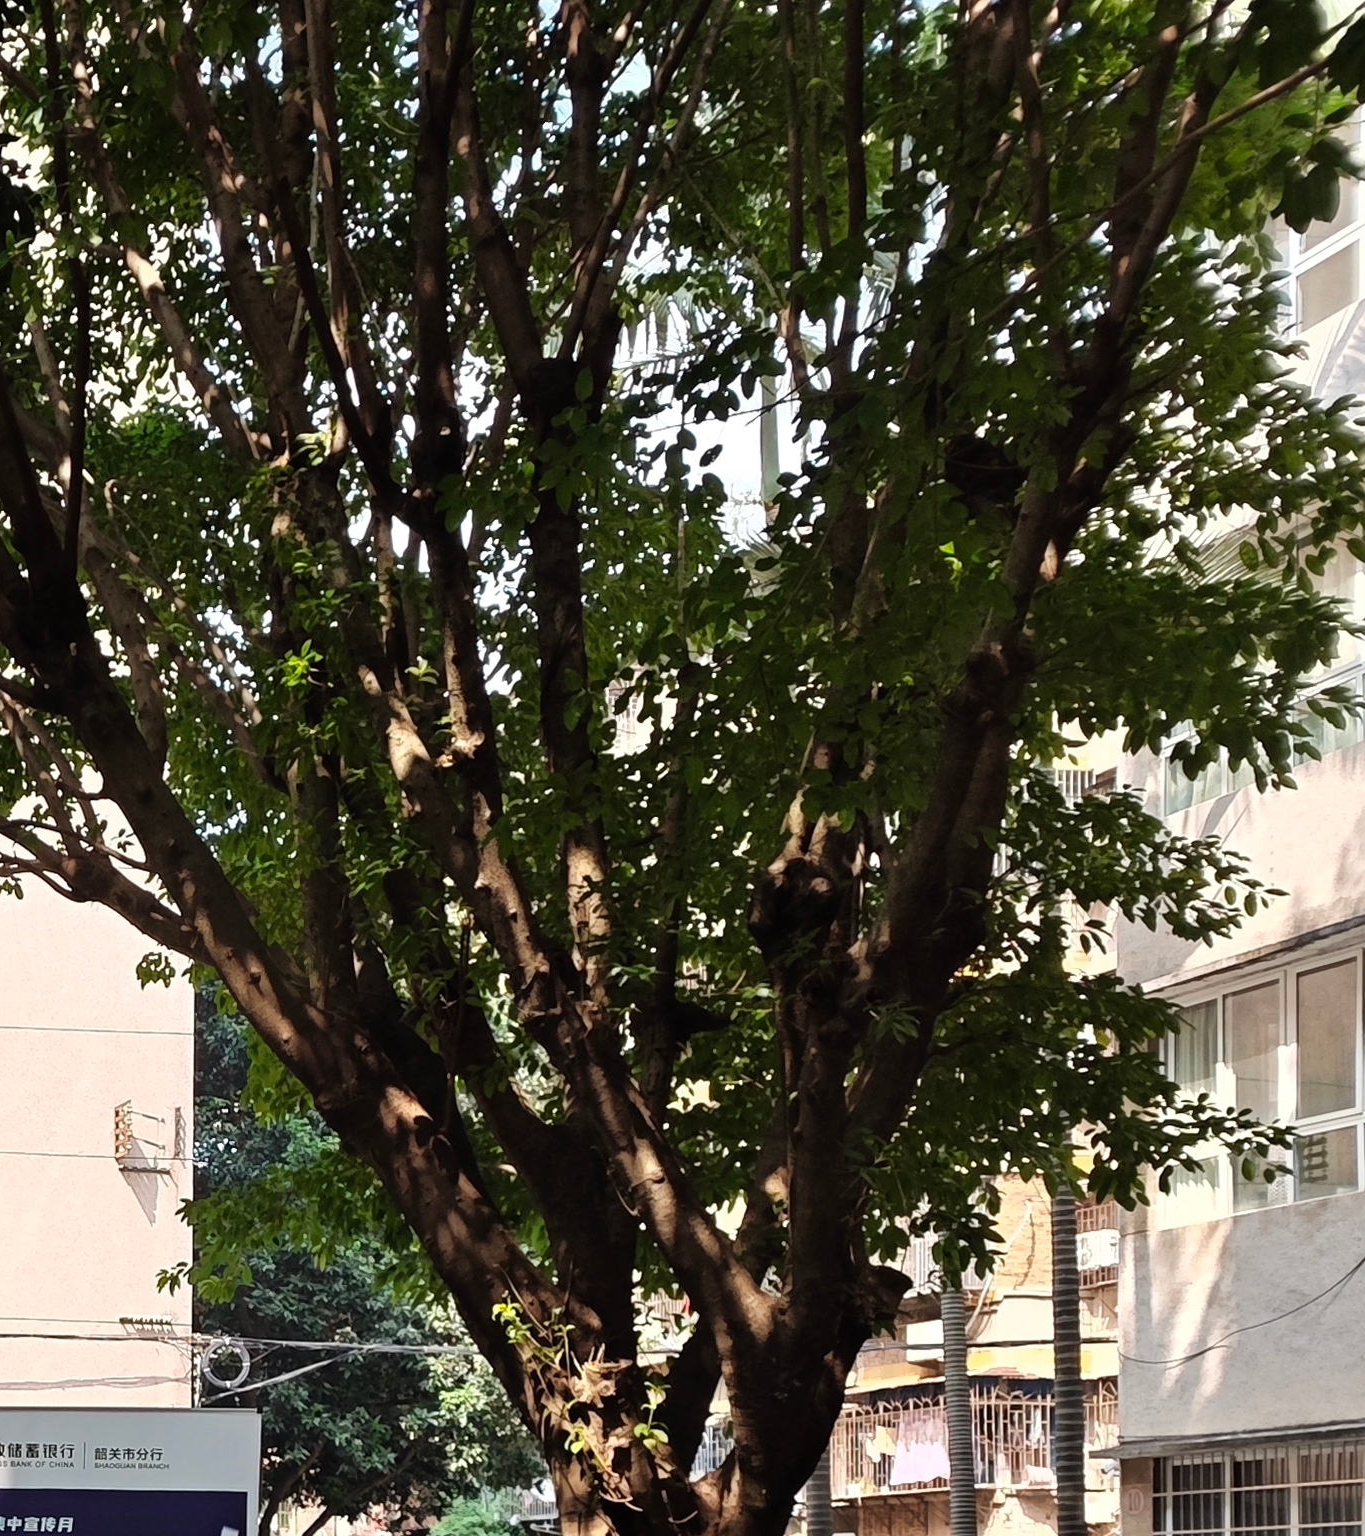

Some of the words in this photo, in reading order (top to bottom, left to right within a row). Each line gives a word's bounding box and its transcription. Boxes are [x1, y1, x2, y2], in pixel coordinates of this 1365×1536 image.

[94, 1447, 165, 1462] 韶关市分行
[10, 1460, 33, 1468] BANK
[35, 1460, 47, 1468] OF
[49, 1460, 75, 1468] CHINA
[1127, 1488, 1144, 1514] 10
